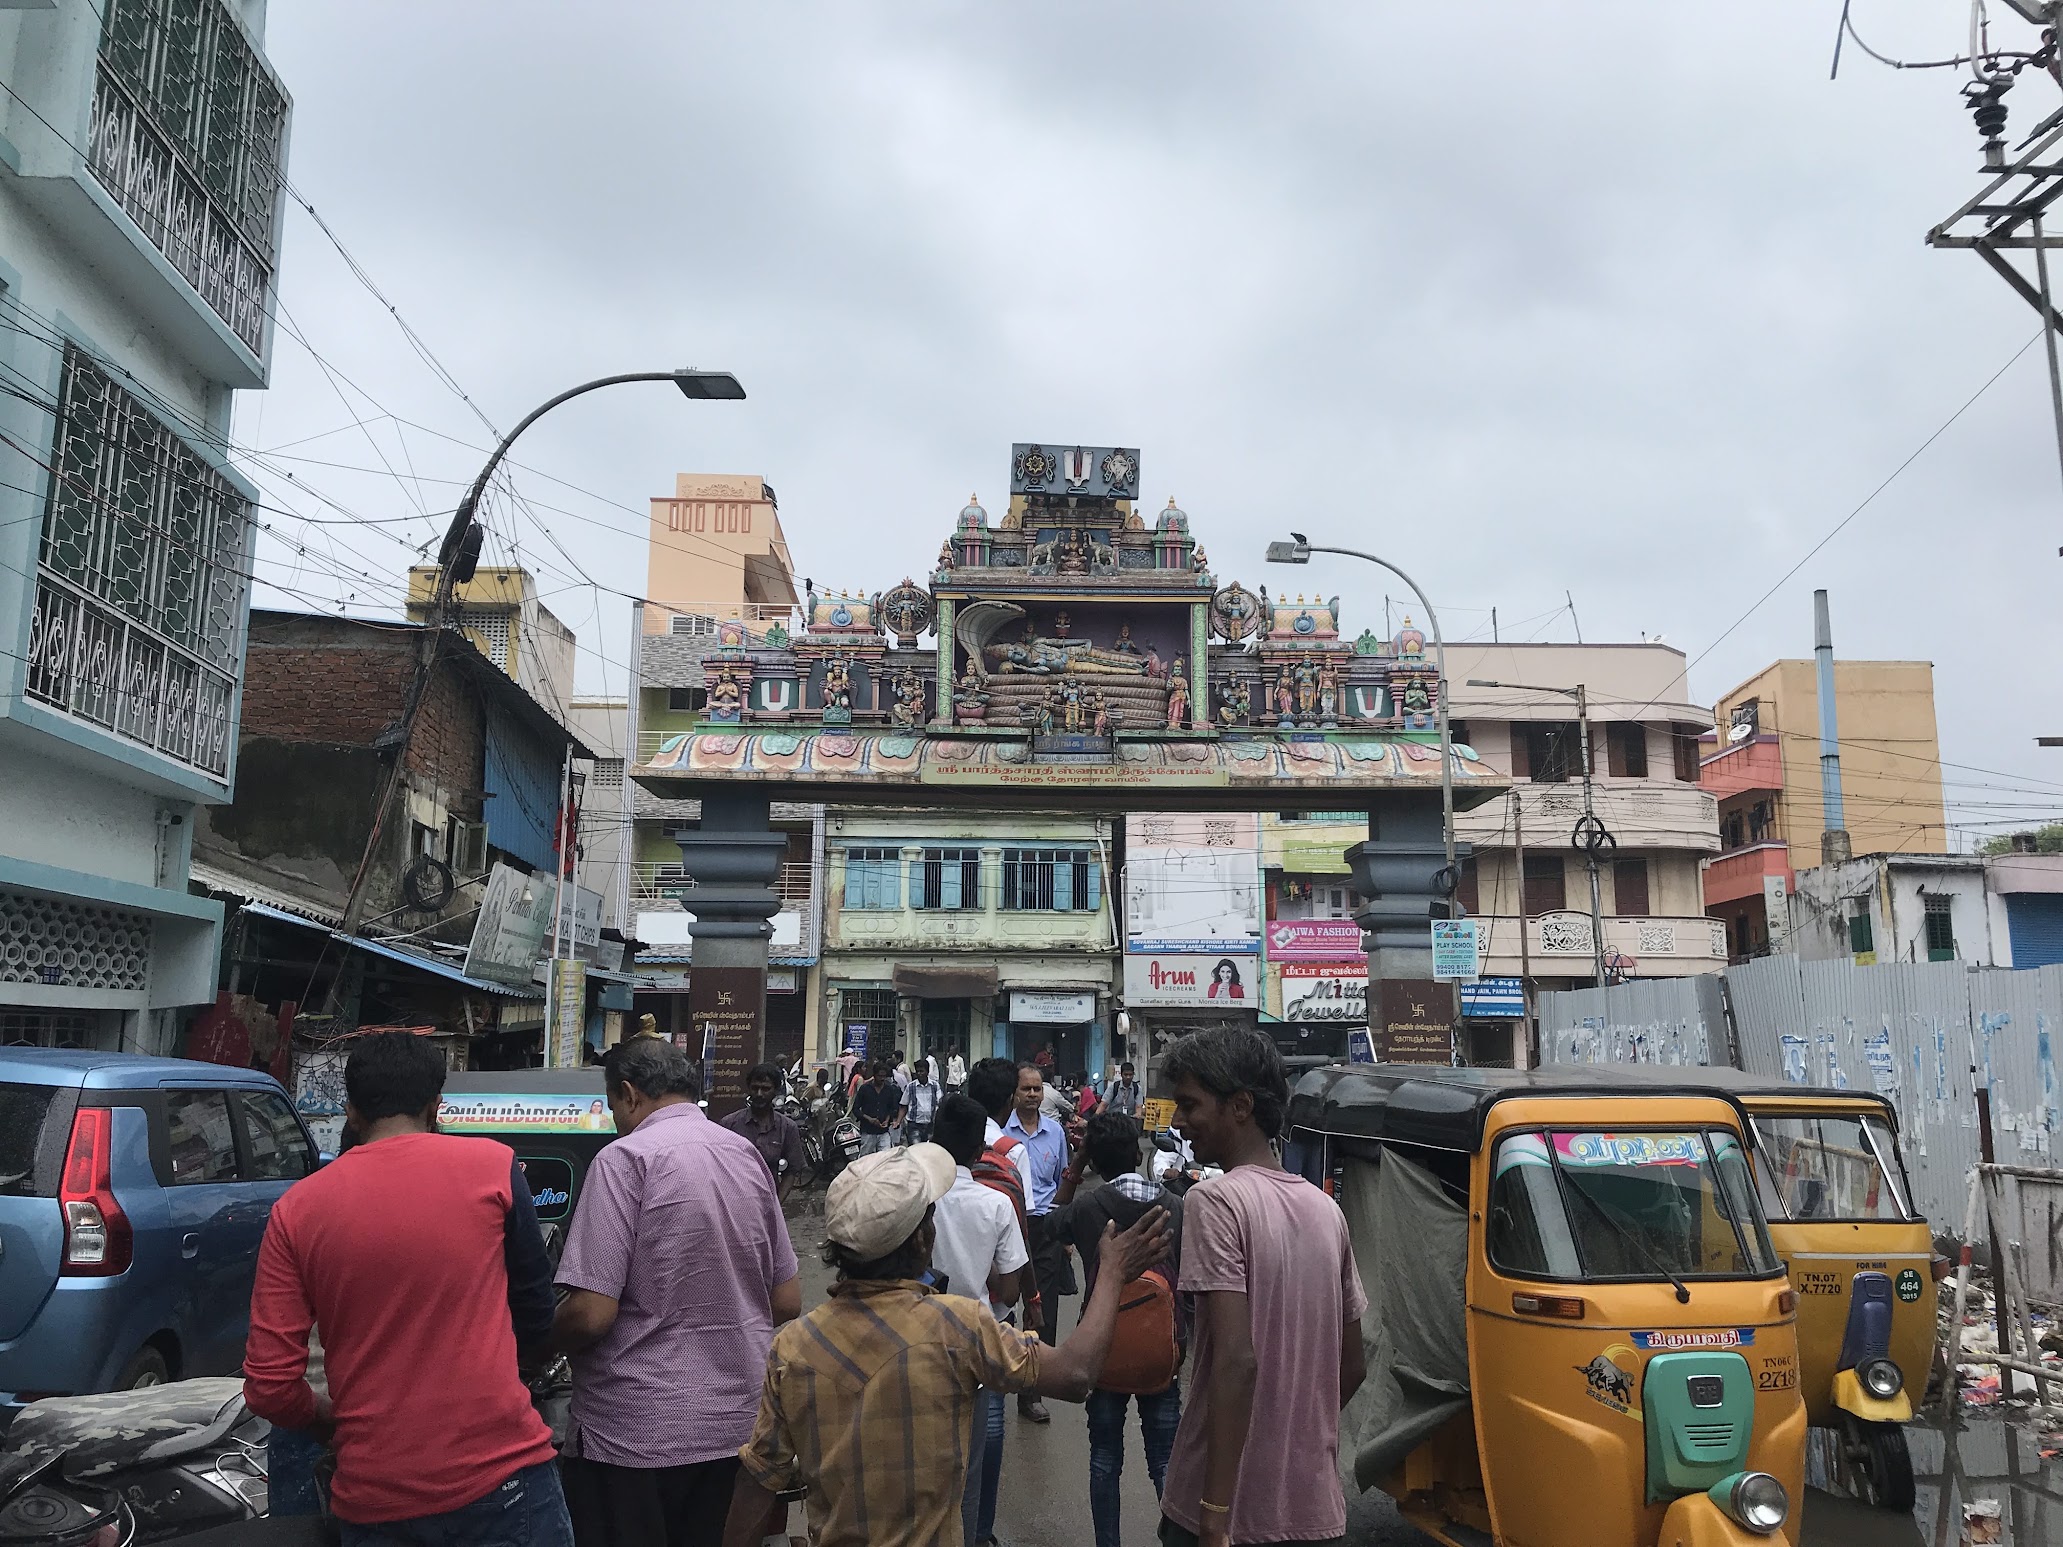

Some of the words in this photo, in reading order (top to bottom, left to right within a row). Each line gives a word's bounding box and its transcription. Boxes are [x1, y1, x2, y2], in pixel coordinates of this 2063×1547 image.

[1316, 927, 1359, 937] FASHION
[1148, 961, 1196, 990] Arun
[532, 1187, 569, 1207] dha
[1804, 1273, 1836, 1282] TN.07
[1800, 1284, 1841, 1294] X.7720
[1900, 1282, 1919, 1291] 464
[1647, 1330, 1741, 1349] கிருபாவதி
[1759, 1369, 1795, 1388] 2718
